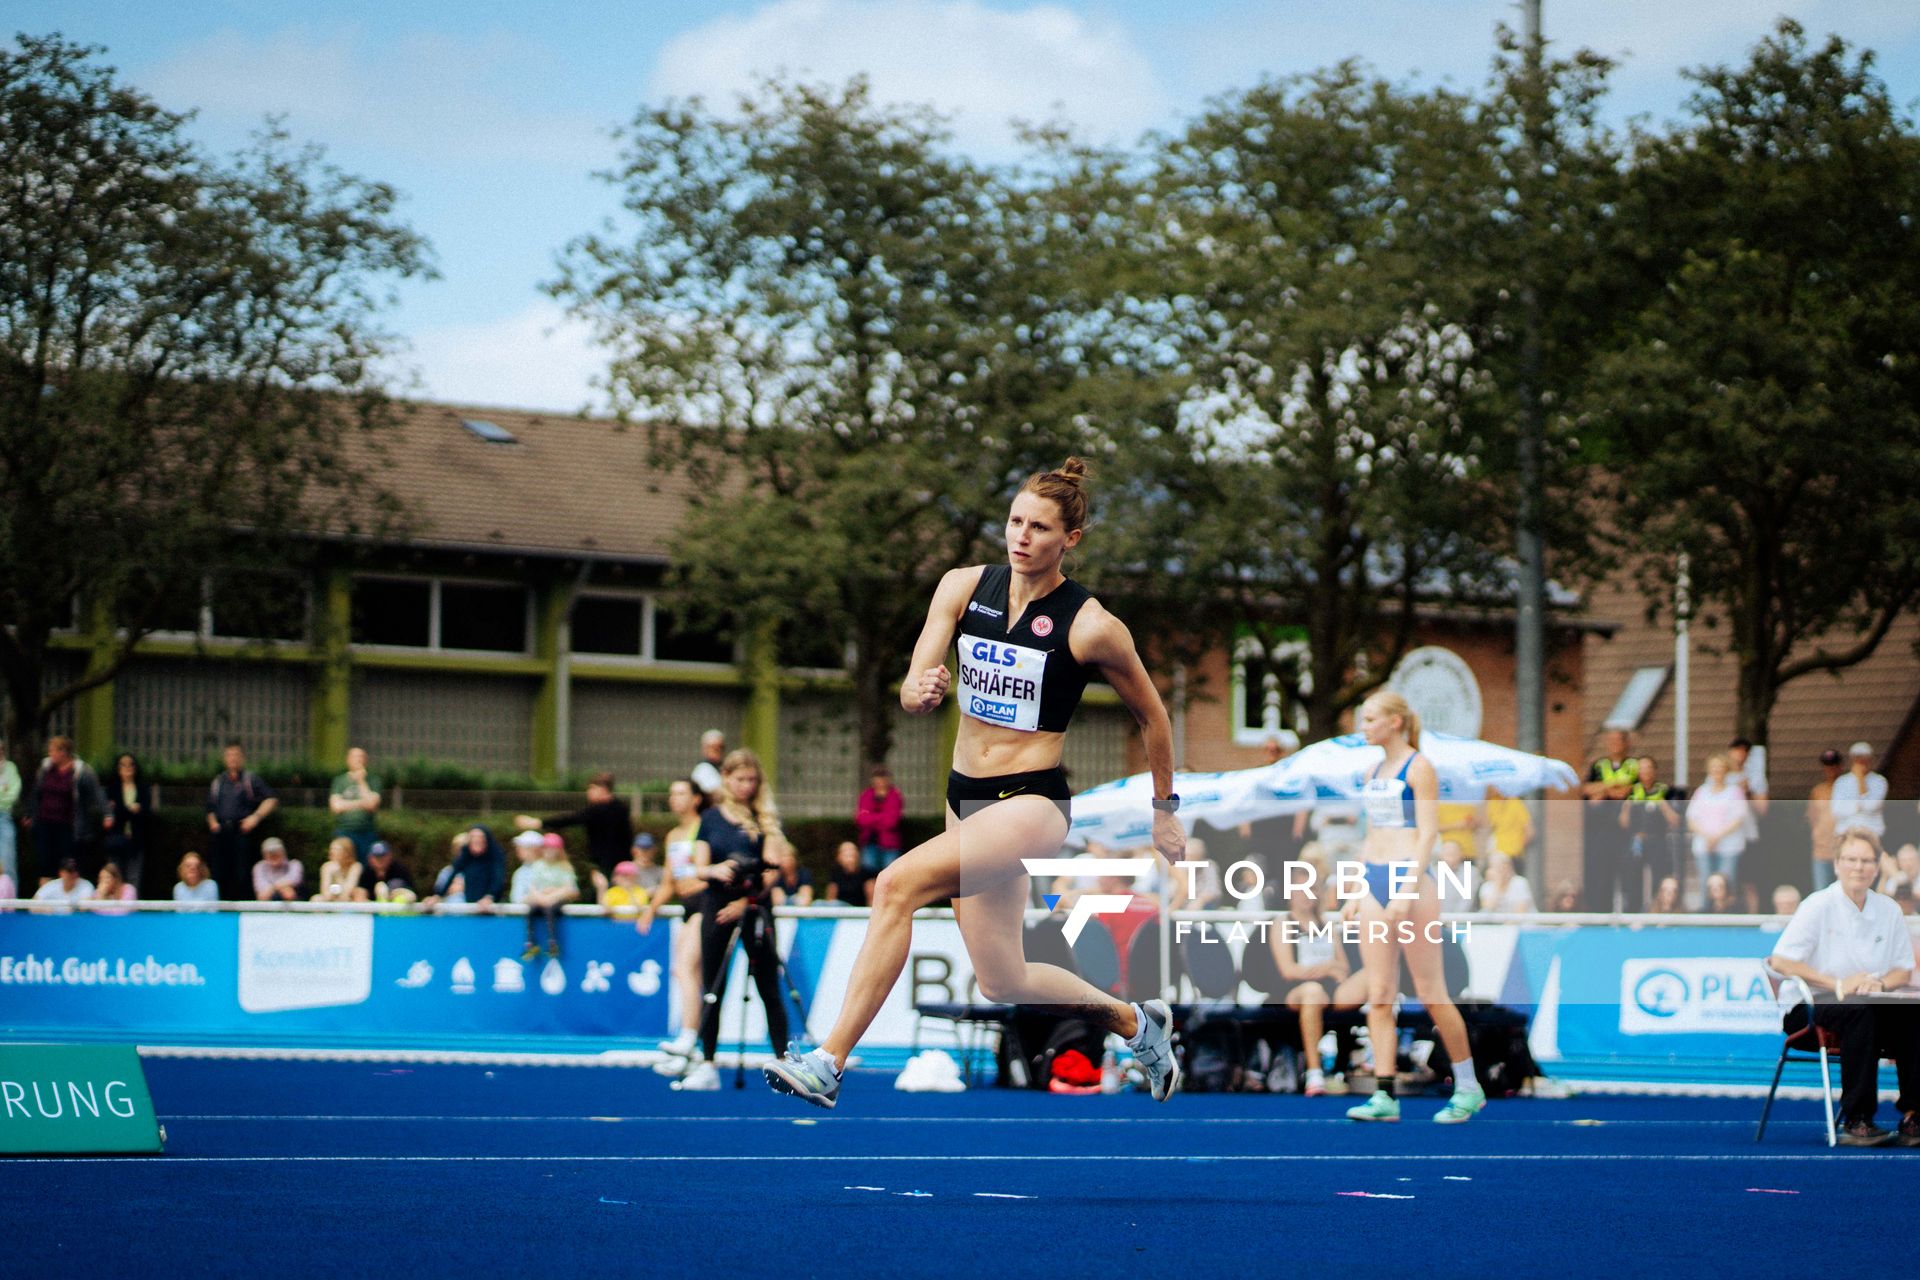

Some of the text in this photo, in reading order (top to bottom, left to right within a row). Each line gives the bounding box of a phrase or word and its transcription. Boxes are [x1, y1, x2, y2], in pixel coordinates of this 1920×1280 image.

[961, 663, 1036, 701] SCHÄFER
[985, 703, 1015, 717] PLAN
[1701, 975, 1768, 1001] PLA
[1, 1080, 135, 1118] RUNG
